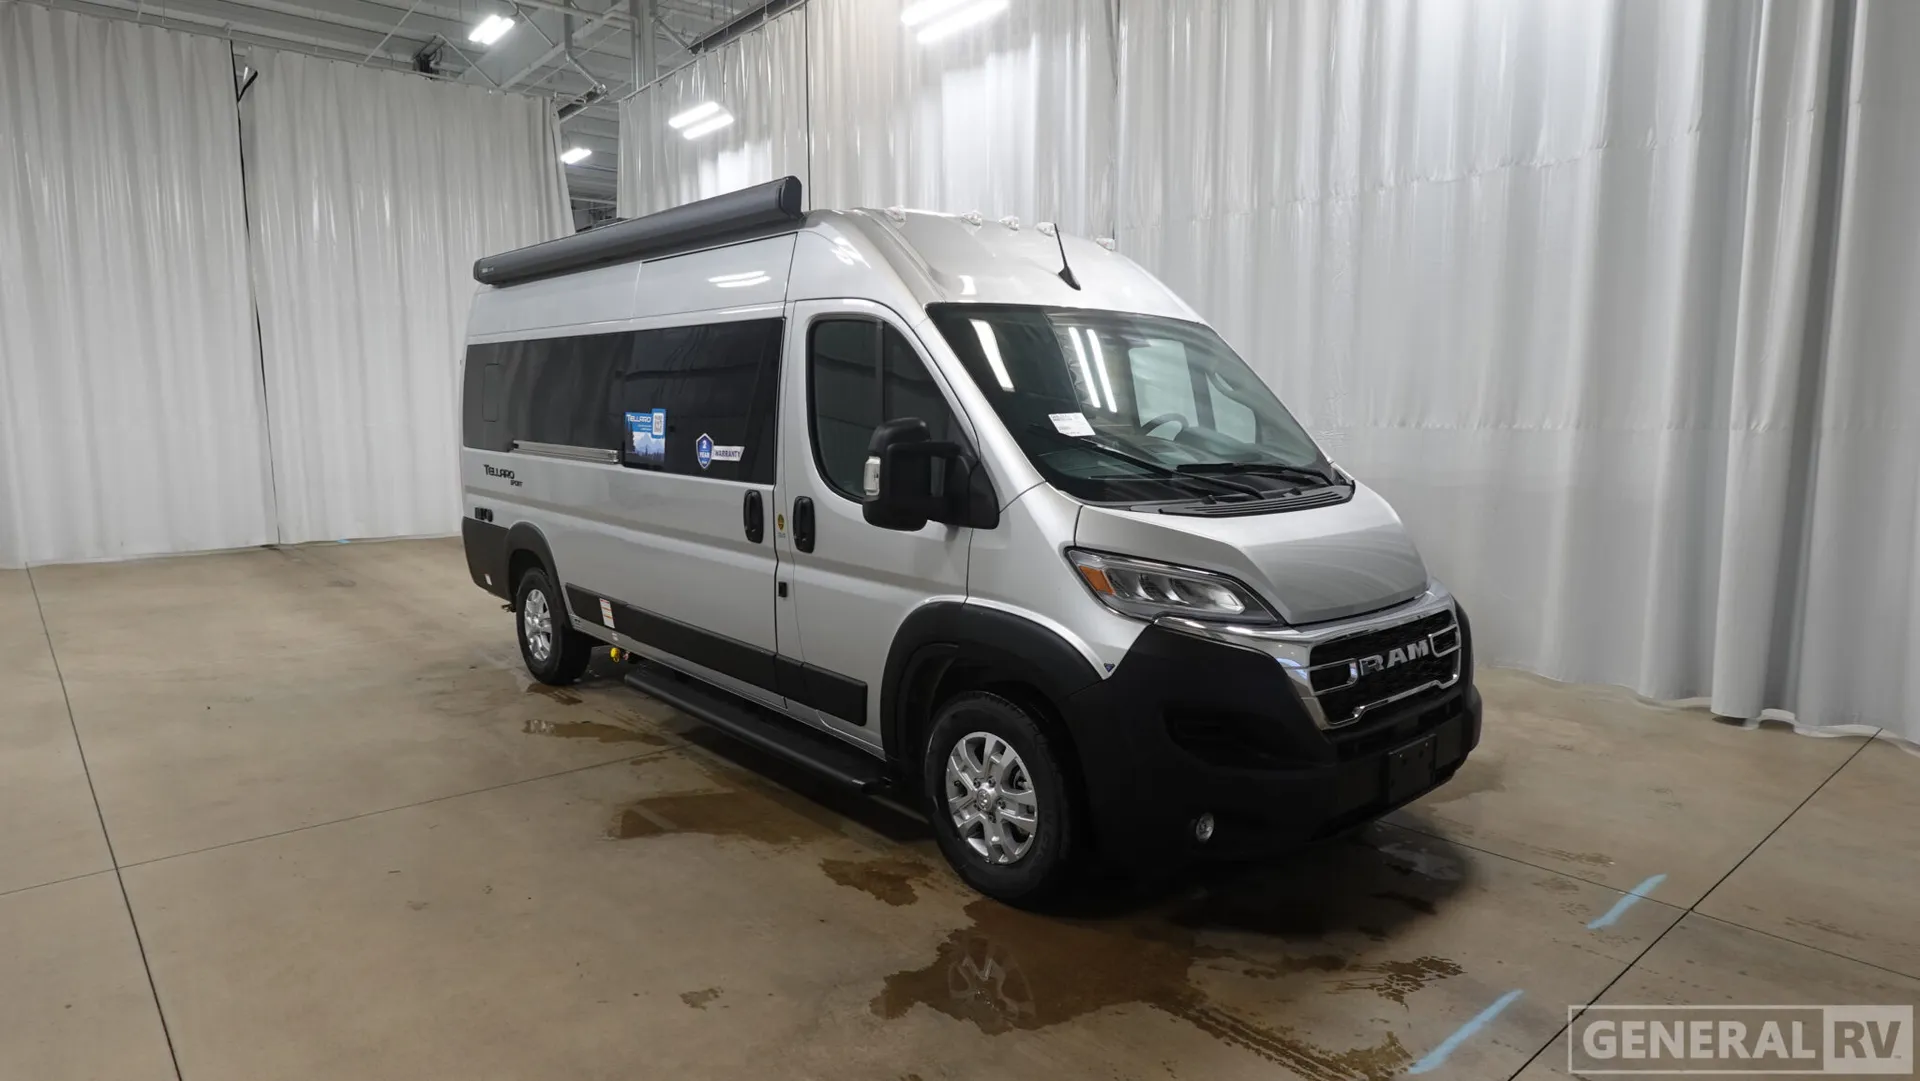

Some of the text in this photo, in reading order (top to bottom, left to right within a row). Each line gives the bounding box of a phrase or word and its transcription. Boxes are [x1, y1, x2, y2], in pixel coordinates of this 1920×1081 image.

[626, 414, 652, 423] TELLARO
[702, 440, 707, 449] 2
[714, 450, 741, 458] WARRANTY
[1359, 639, 1429, 676] RAM
